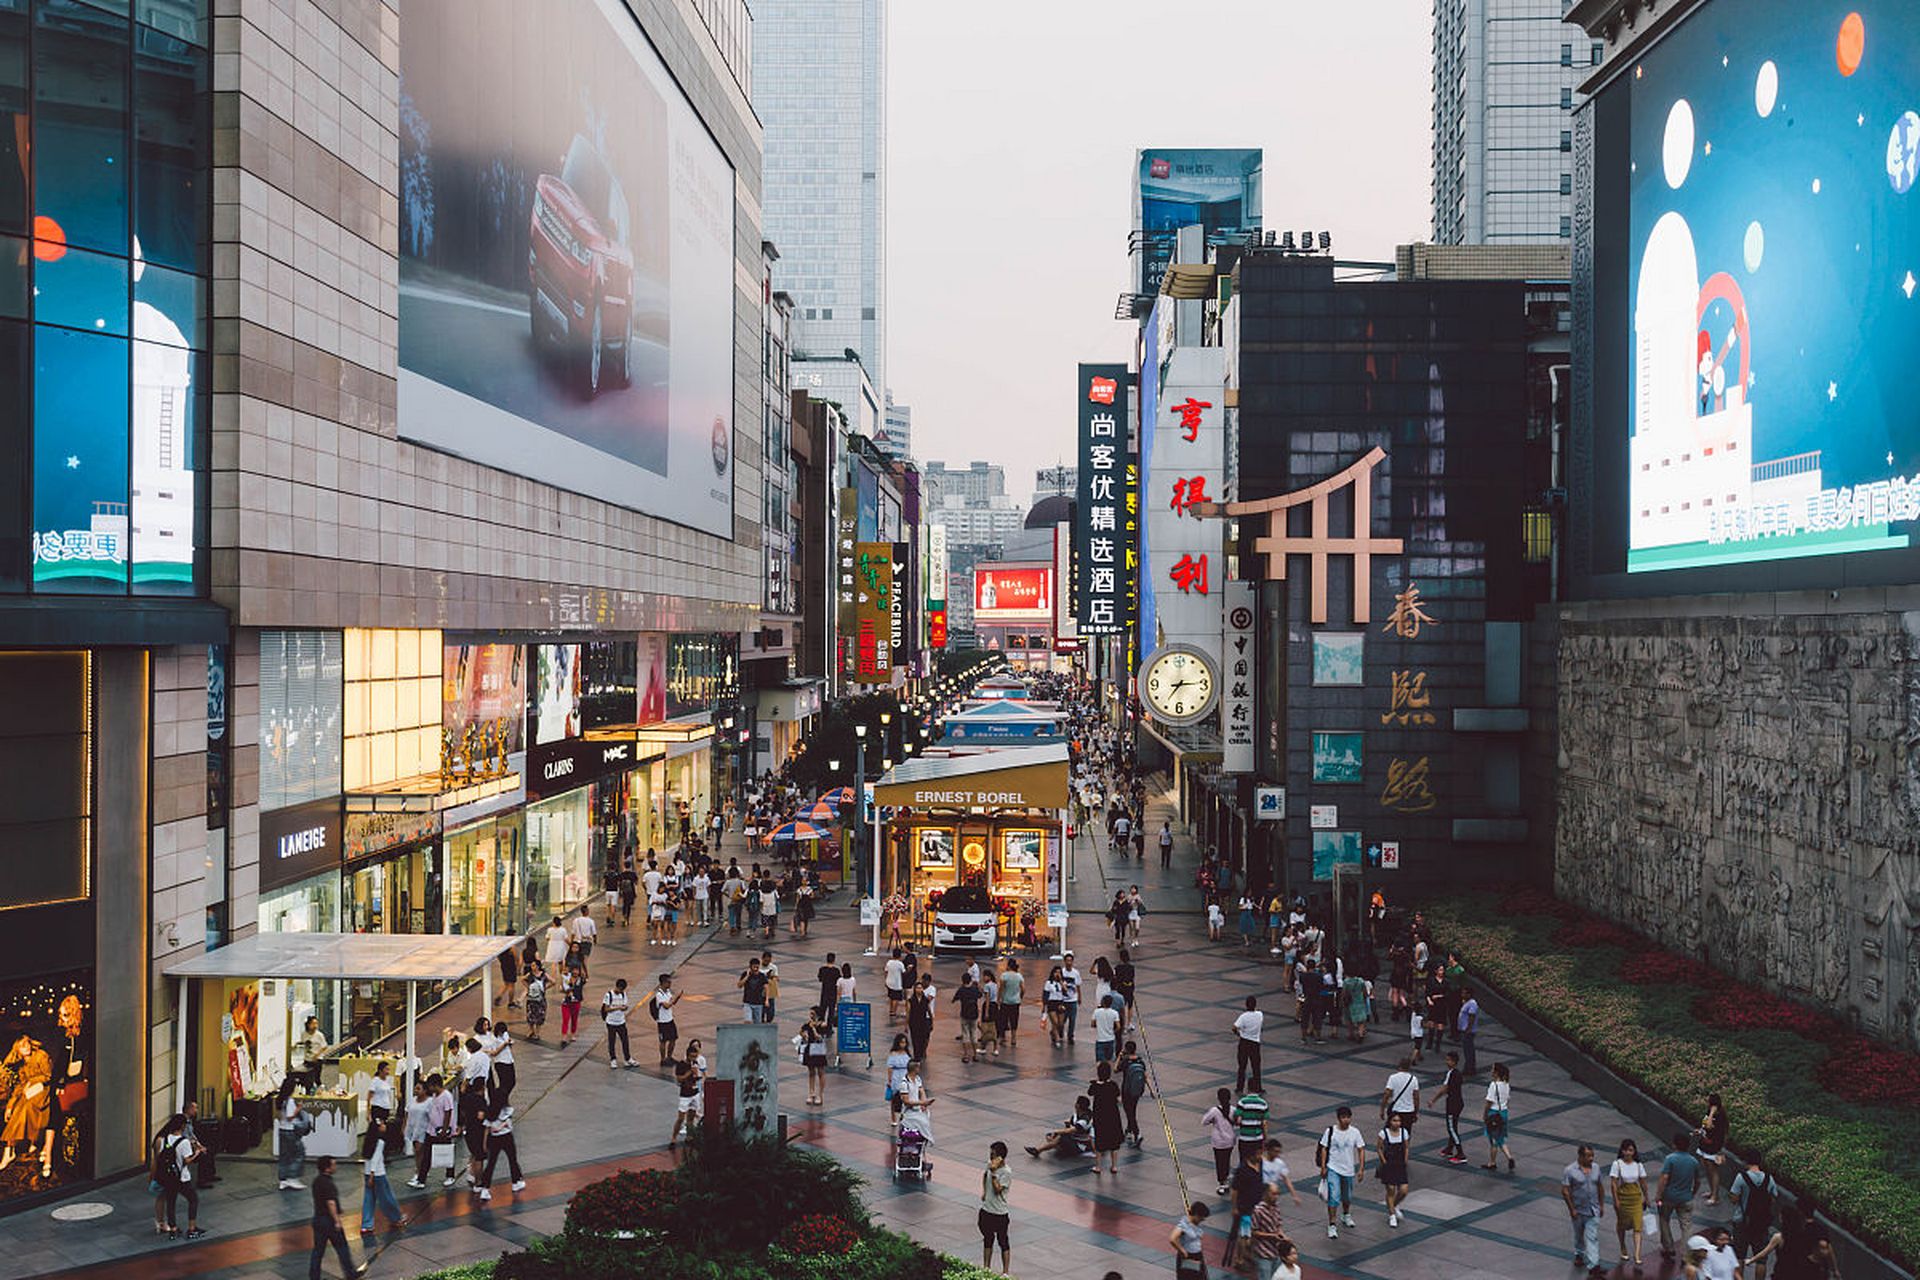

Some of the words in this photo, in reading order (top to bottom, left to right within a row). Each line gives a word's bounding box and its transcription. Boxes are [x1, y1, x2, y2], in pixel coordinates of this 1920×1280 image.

[1090, 412, 1116, 624] 尚客优精选酒店
[891, 581, 902, 648] PEACEBIRD
[1150, 678, 1159, 690] 9
[1199, 679, 1208, 690] 3
[1175, 702, 1183, 714] 6
[544, 757, 574, 780] CLARINS
[915, 791, 973, 803] ERNEST
[977, 792, 1025, 804] BOREL
[279, 826, 326, 859] LANEIGE
